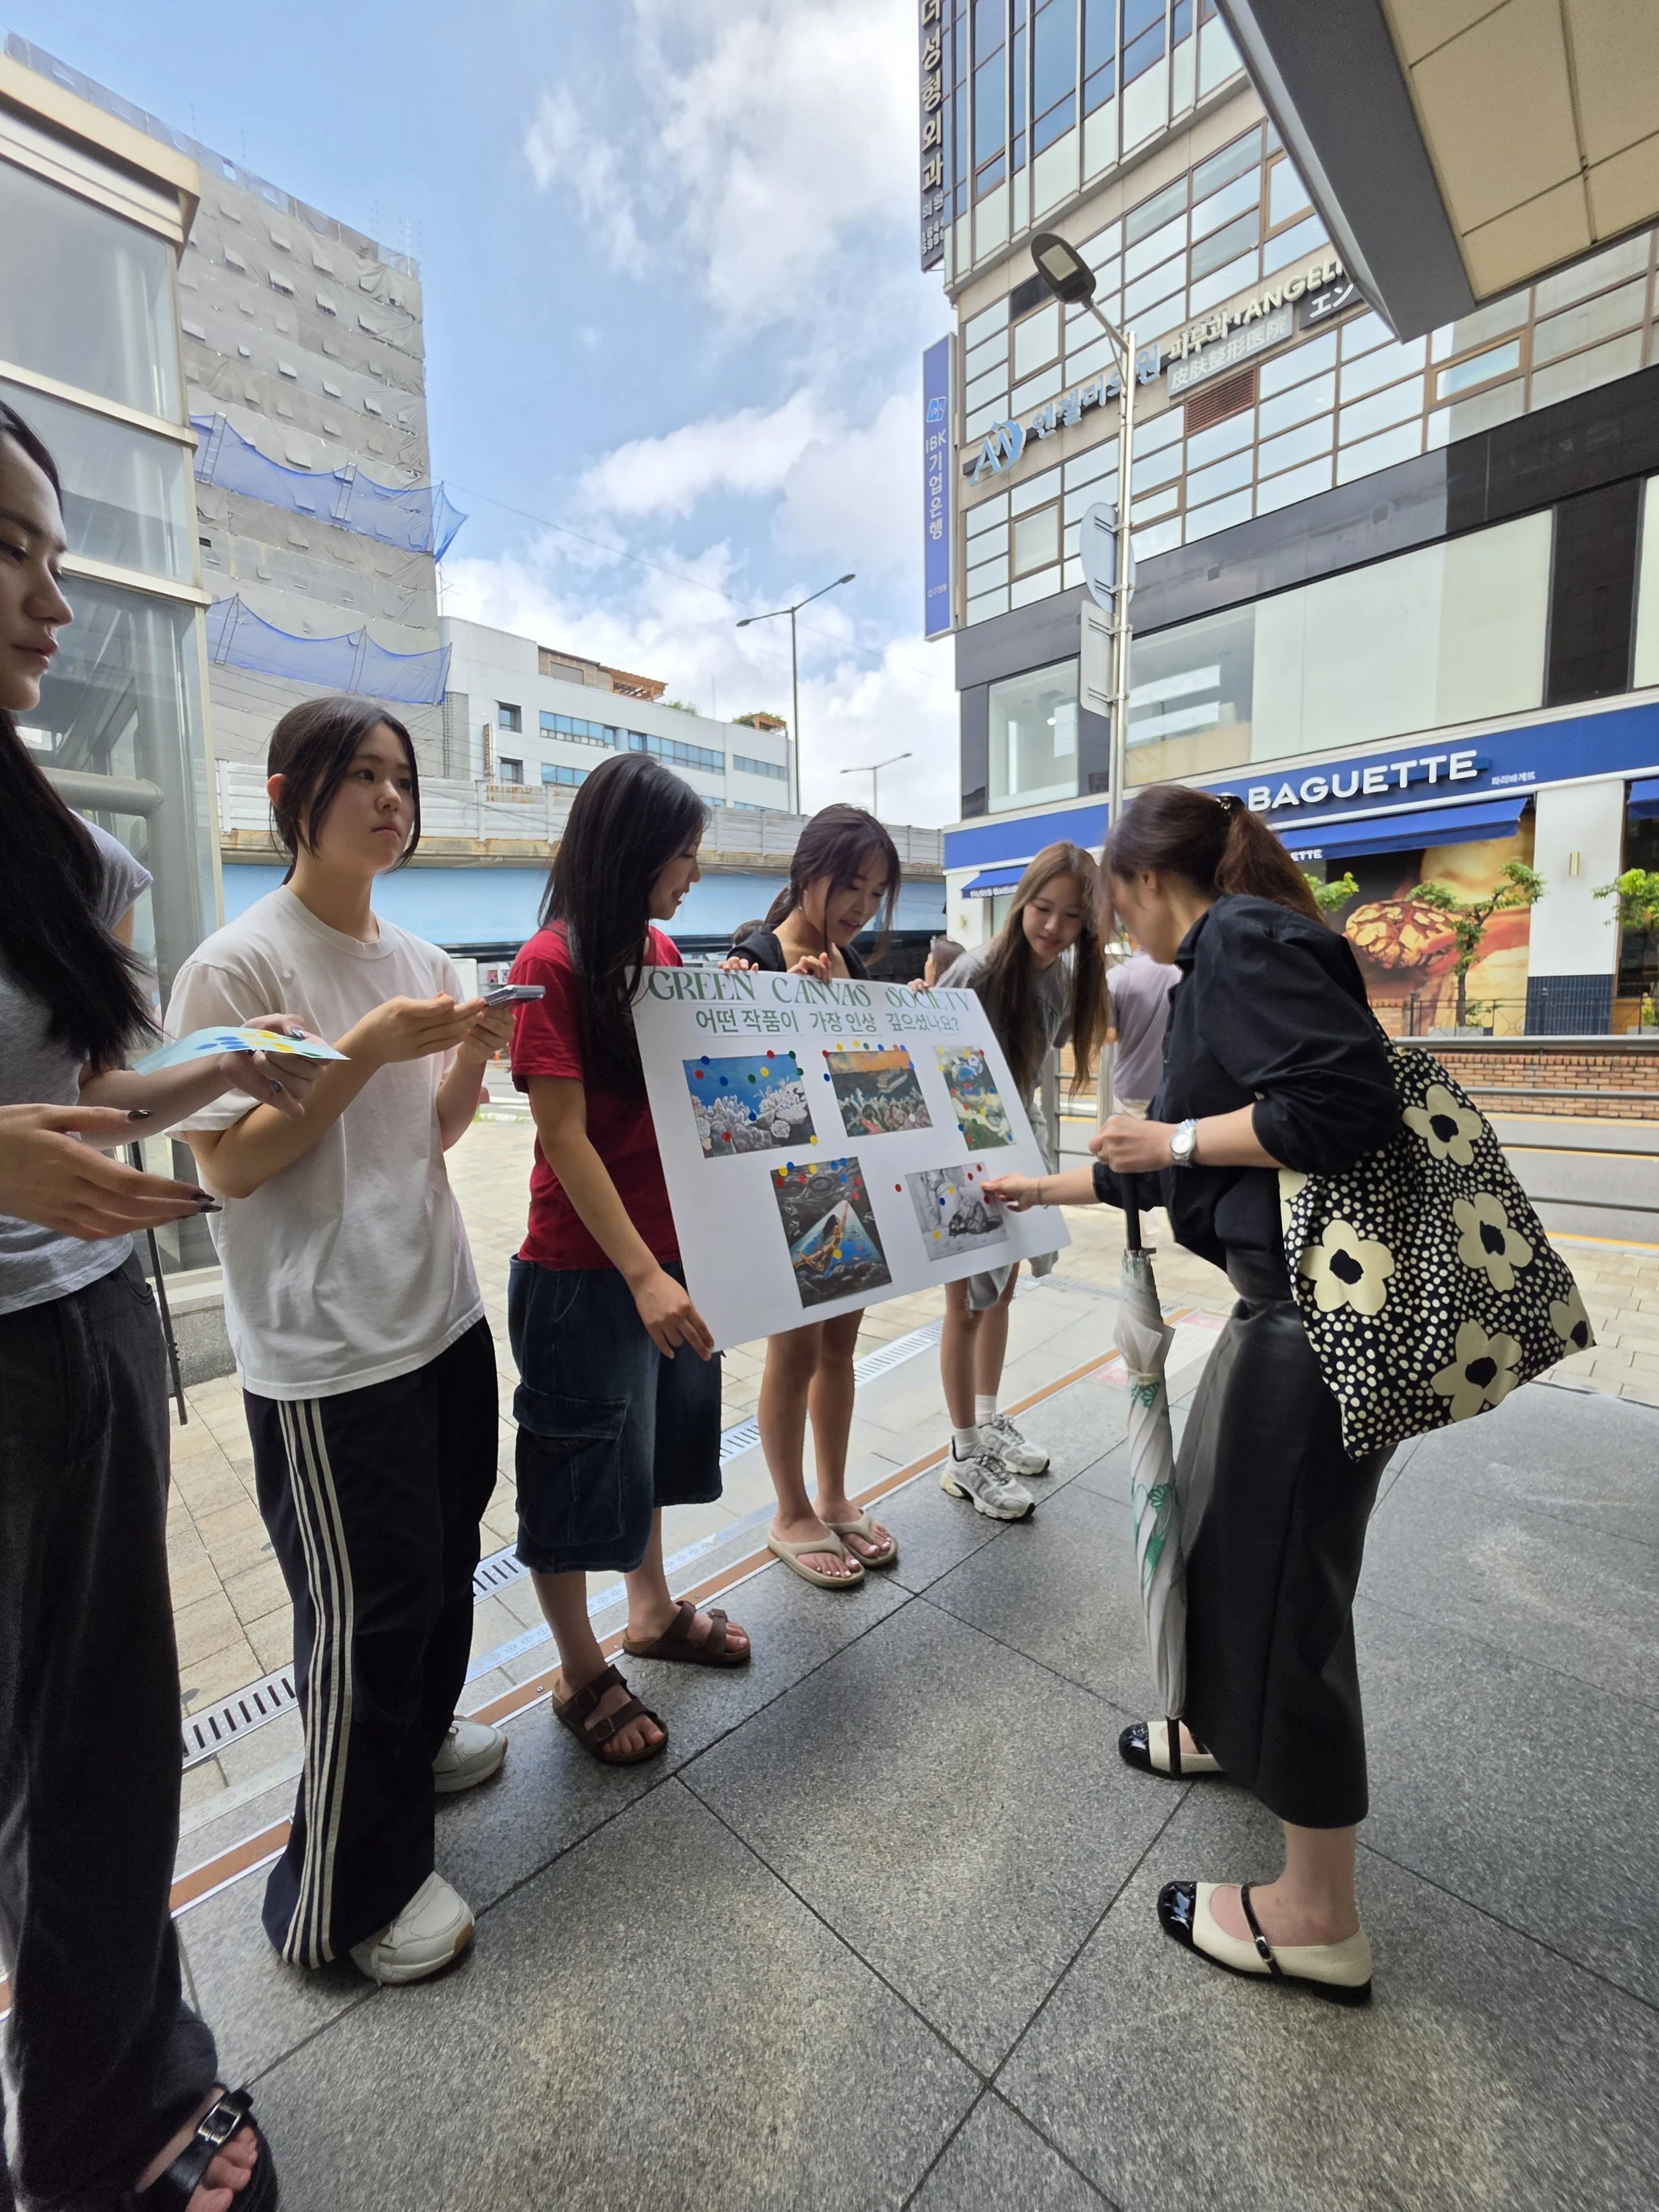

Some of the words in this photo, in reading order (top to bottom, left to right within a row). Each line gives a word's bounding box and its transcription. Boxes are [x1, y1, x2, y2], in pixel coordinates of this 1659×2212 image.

[1168, 309, 1232, 360] 피부과
[1171, 315, 1287, 390] 皮肤整形医院
[926, 429, 947, 454] IBK
[929, 451, 943, 540] 기업은행
[1248, 749, 1478, 812] BAGUETTE
[1491, 771, 1536, 786] 파리바게뜨
[1290, 848, 1323, 861] ETTE
[970, 888, 993, 898] PARIS
[648, 970, 756, 1001] GREEN
[771, 976, 871, 1008] CANVAS
[885, 986, 970, 1012] SOCIETY
[695, 1007, 739, 1034] 어떤
[741, 1009, 800, 1033] 작품이
[809, 1010, 841, 1033] 가장
[845, 1011, 877, 1033] 인상
[885, 1012, 960, 1032] 깊으셨나요?
